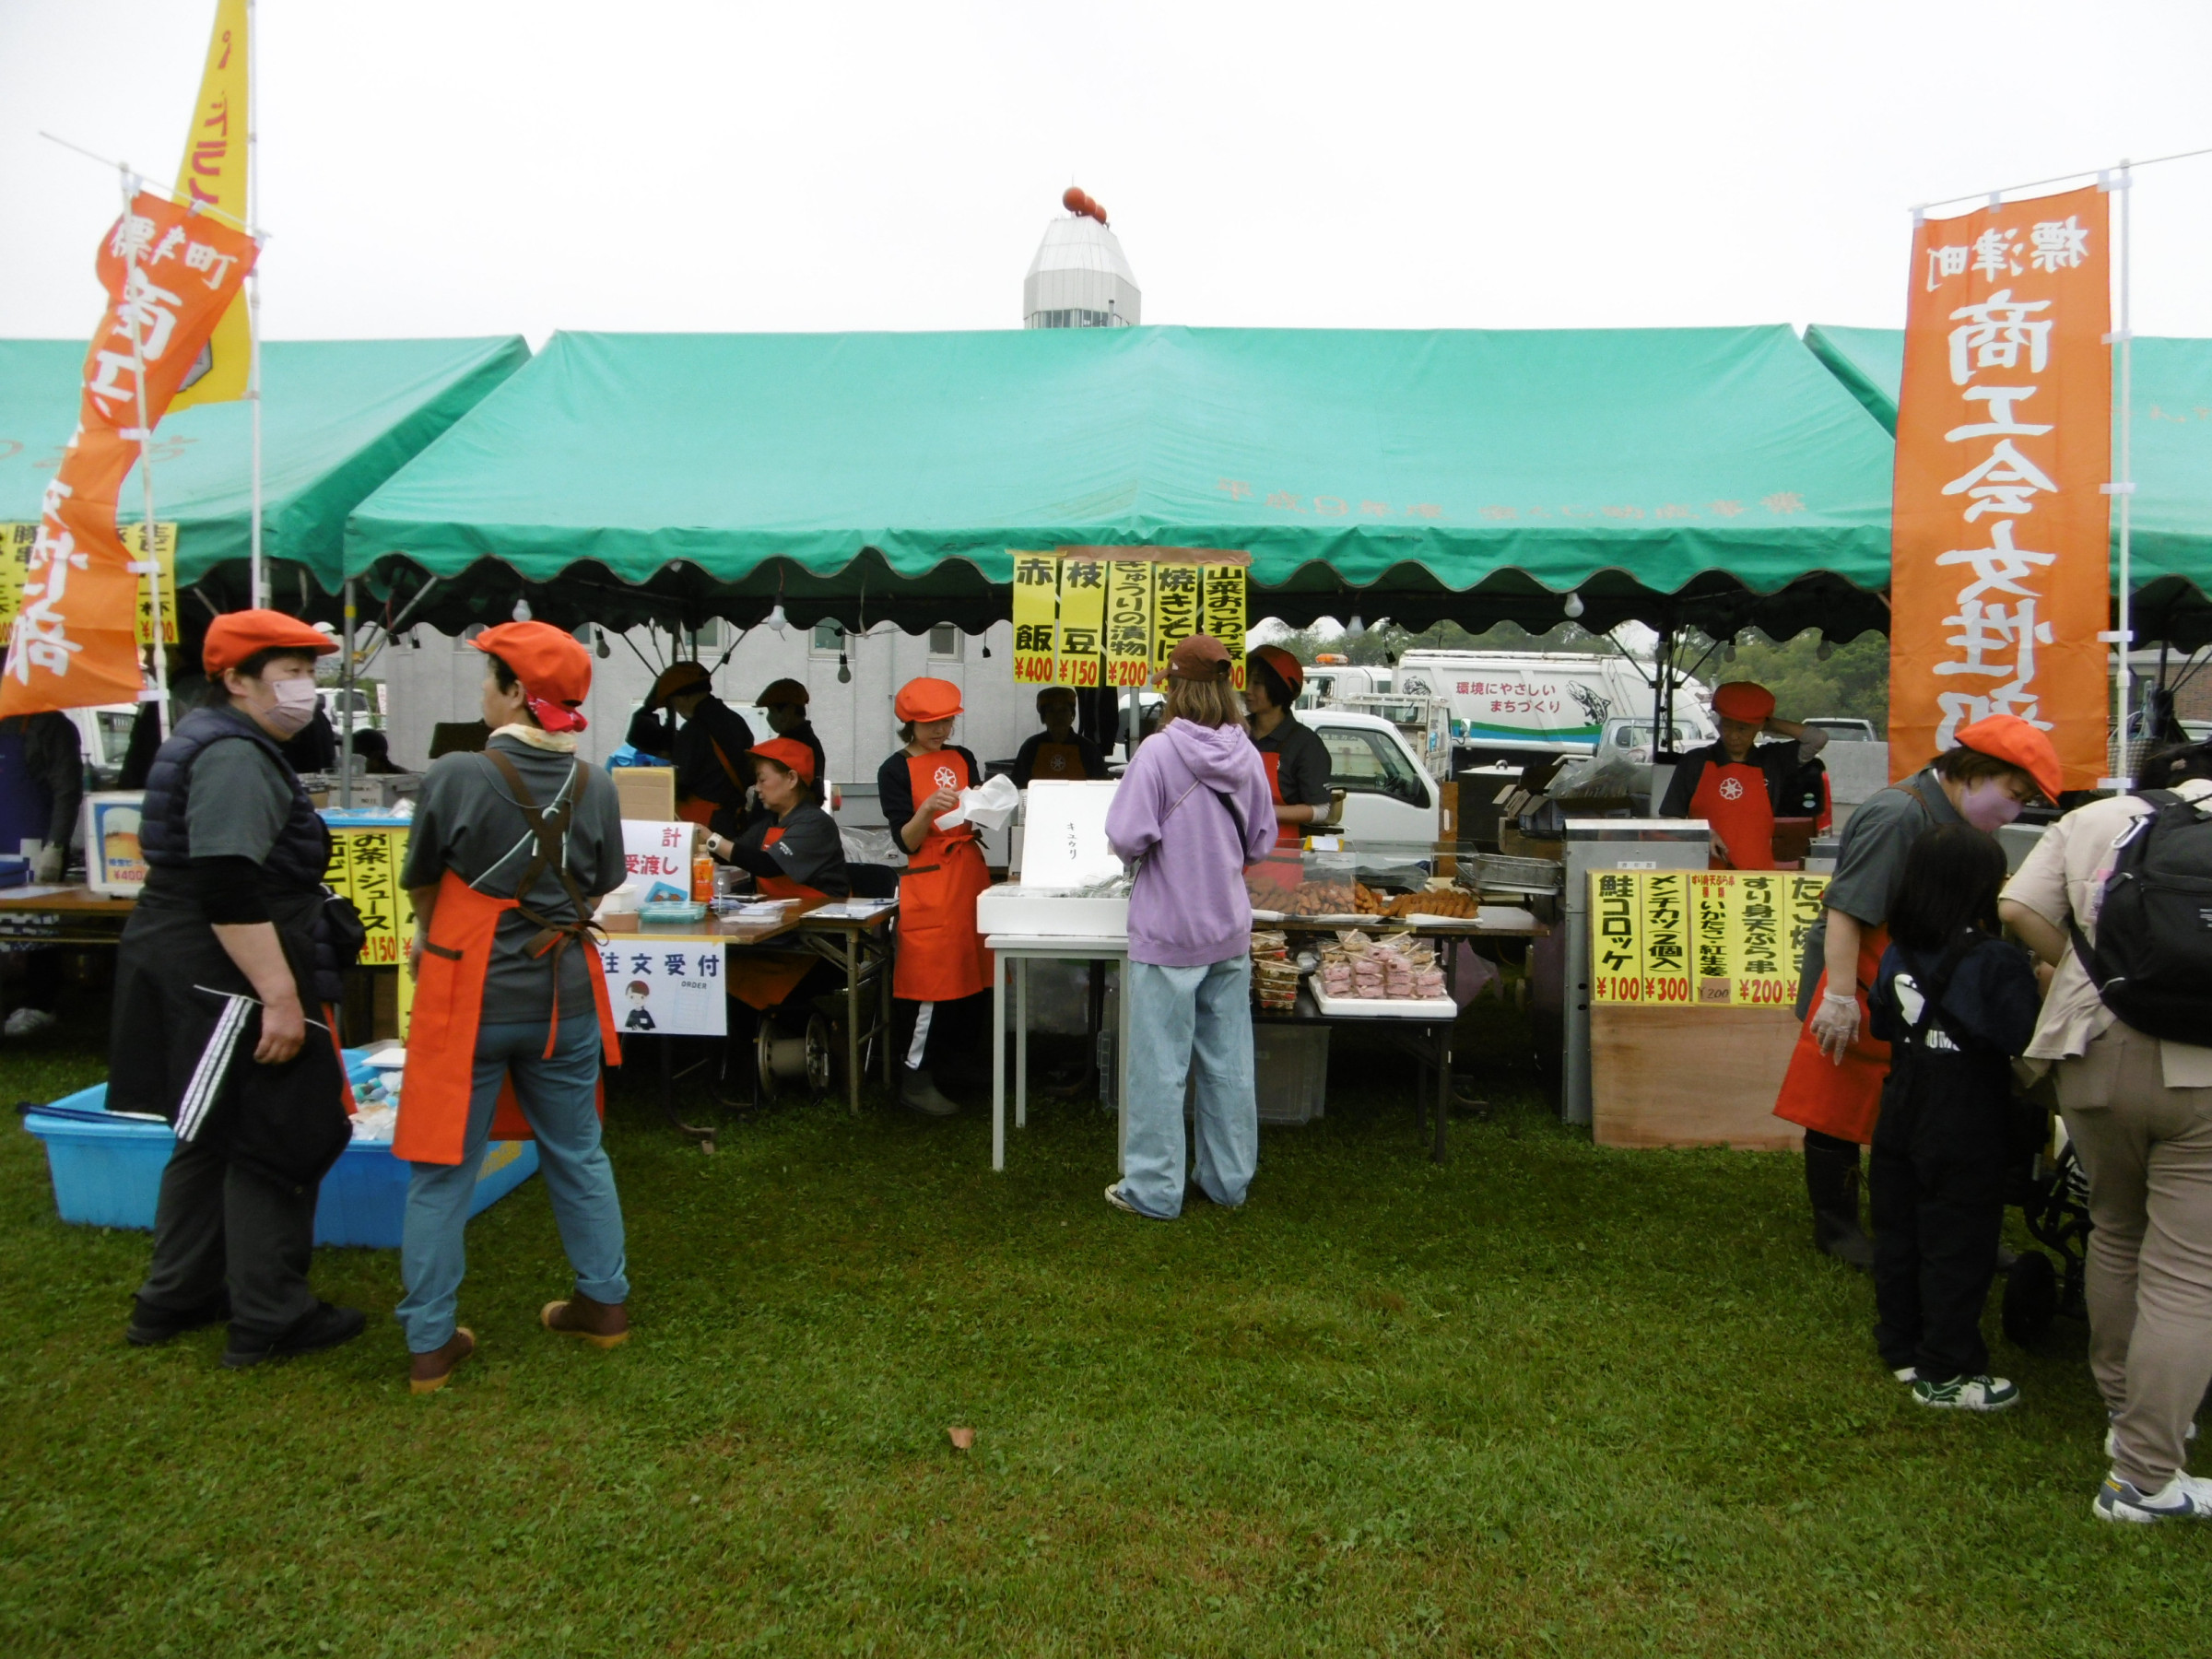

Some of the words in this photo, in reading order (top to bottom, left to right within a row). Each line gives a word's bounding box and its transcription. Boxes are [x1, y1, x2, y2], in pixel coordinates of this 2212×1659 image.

[1016, 558, 1054, 653] 赤飯
[1061, 561, 1104, 655] 枝豆
[1109, 559, 1147, 657] きゅうりの漬物
[1015, 656, 1053, 683] ¥400
[1059, 659, 1098, 686] ¥150
[1108, 661, 1147, 687] ¥200
[1455, 680, 1557, 697] 環境にやさしい
[1489, 699, 1561, 714] まちづくり
[352, 833, 391, 931] お茶・ジュース
[1598, 875, 1634, 971] 鮭コロッケ
[1741, 877, 1778, 975] すり身天ぷら串
[600, 951, 720, 977] 注文受付
[680, 981, 708, 990] ORDER
[1596, 976, 1641, 1002] ¥100
[1644, 977, 1688, 1002] ¥300
[1739, 979, 1783, 1004] ¥200
[1924, 1029, 1960, 1052] UM
